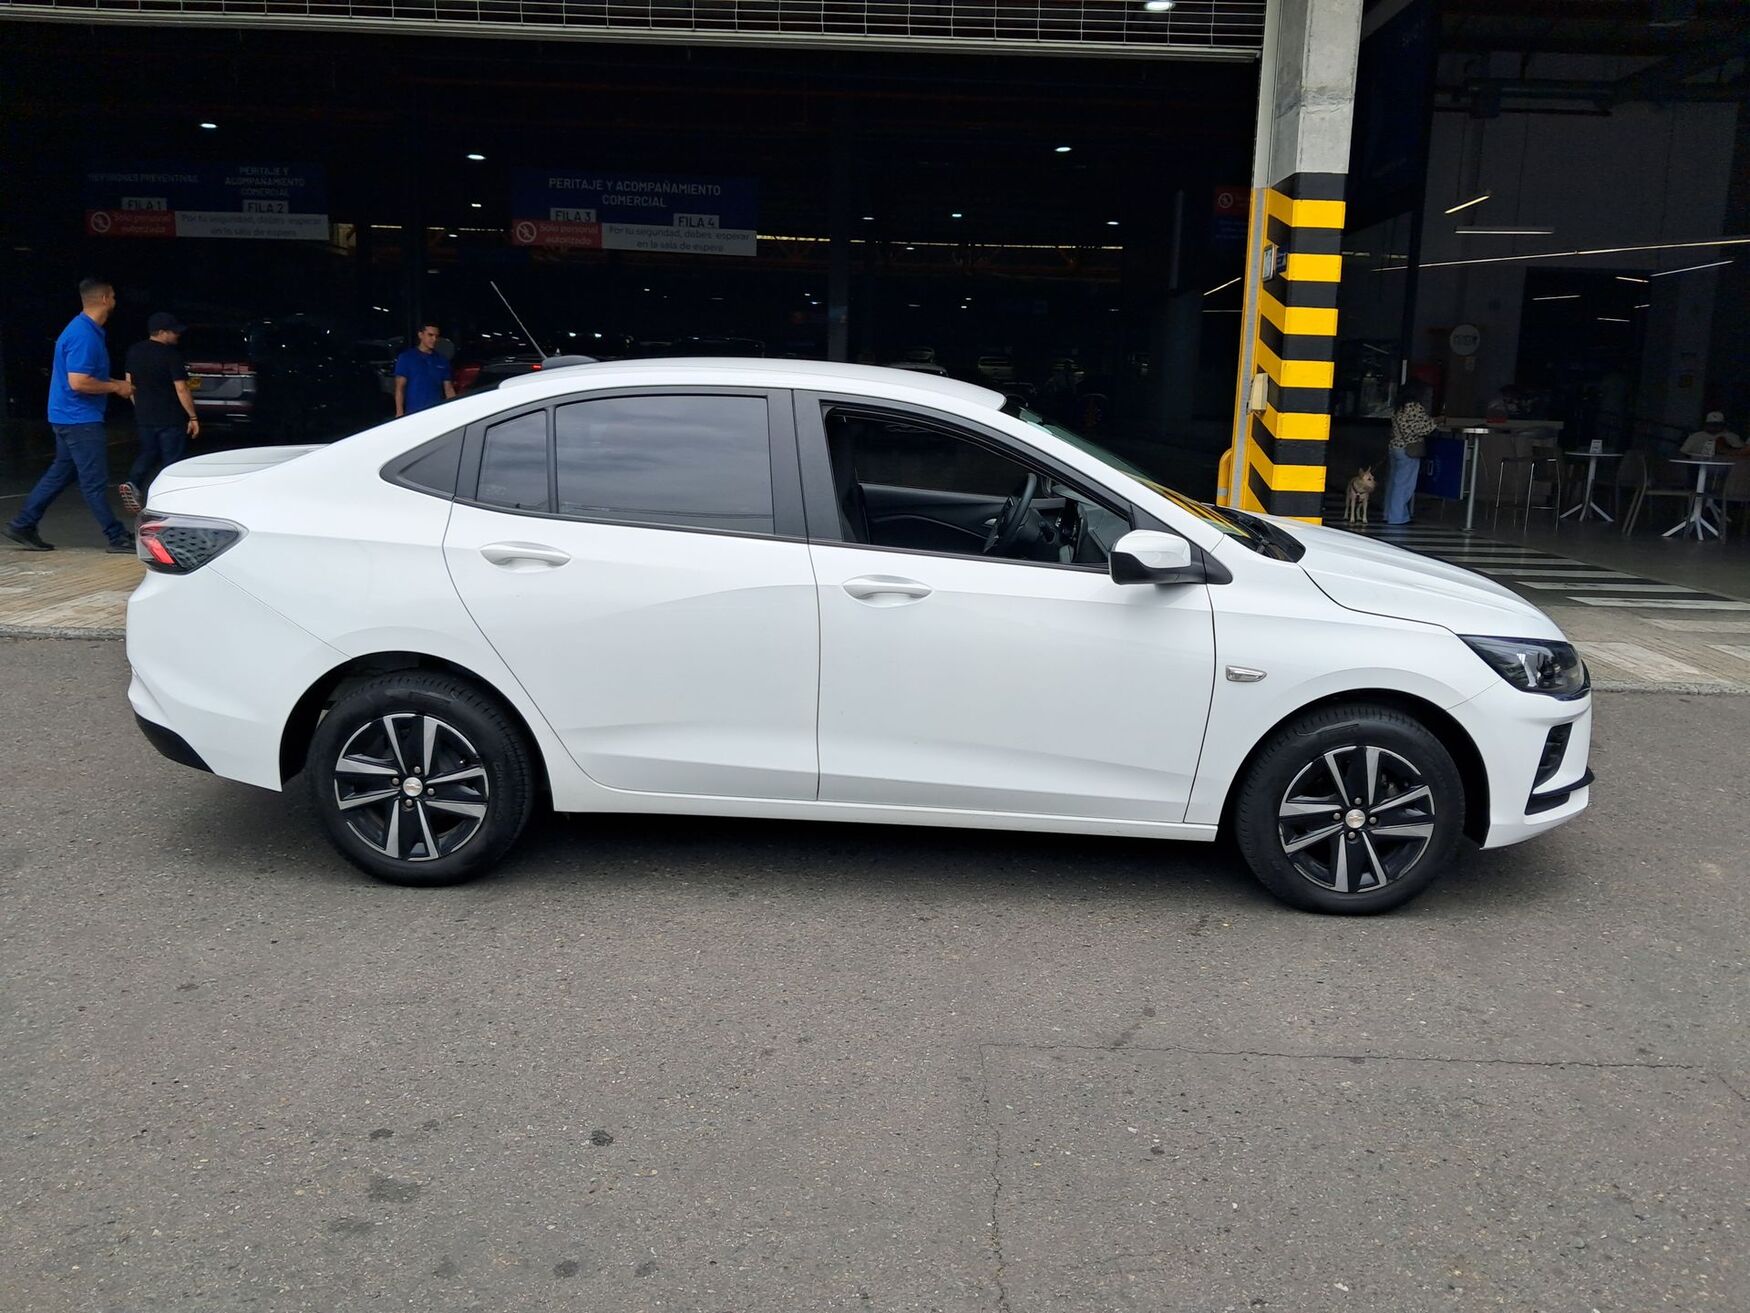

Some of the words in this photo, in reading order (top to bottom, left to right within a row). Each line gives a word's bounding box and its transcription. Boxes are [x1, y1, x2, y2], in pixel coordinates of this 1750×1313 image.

[548, 177, 604, 190] PERITAJE
[605, 179, 614, 191] Y
[615, 179, 721, 197] ACOMPAÑAMIENTO
[128, 200, 153, 210] FILA
[602, 194, 667, 208] COMERCIAL
[248, 202, 273, 213] FILA
[277, 203, 284, 213] 2
[555, 210, 581, 222] FILA
[584, 210, 591, 222] 3
[678, 216, 704, 228] FILA
[707, 217, 715, 228] 4
[636, 240, 649, 248] en
